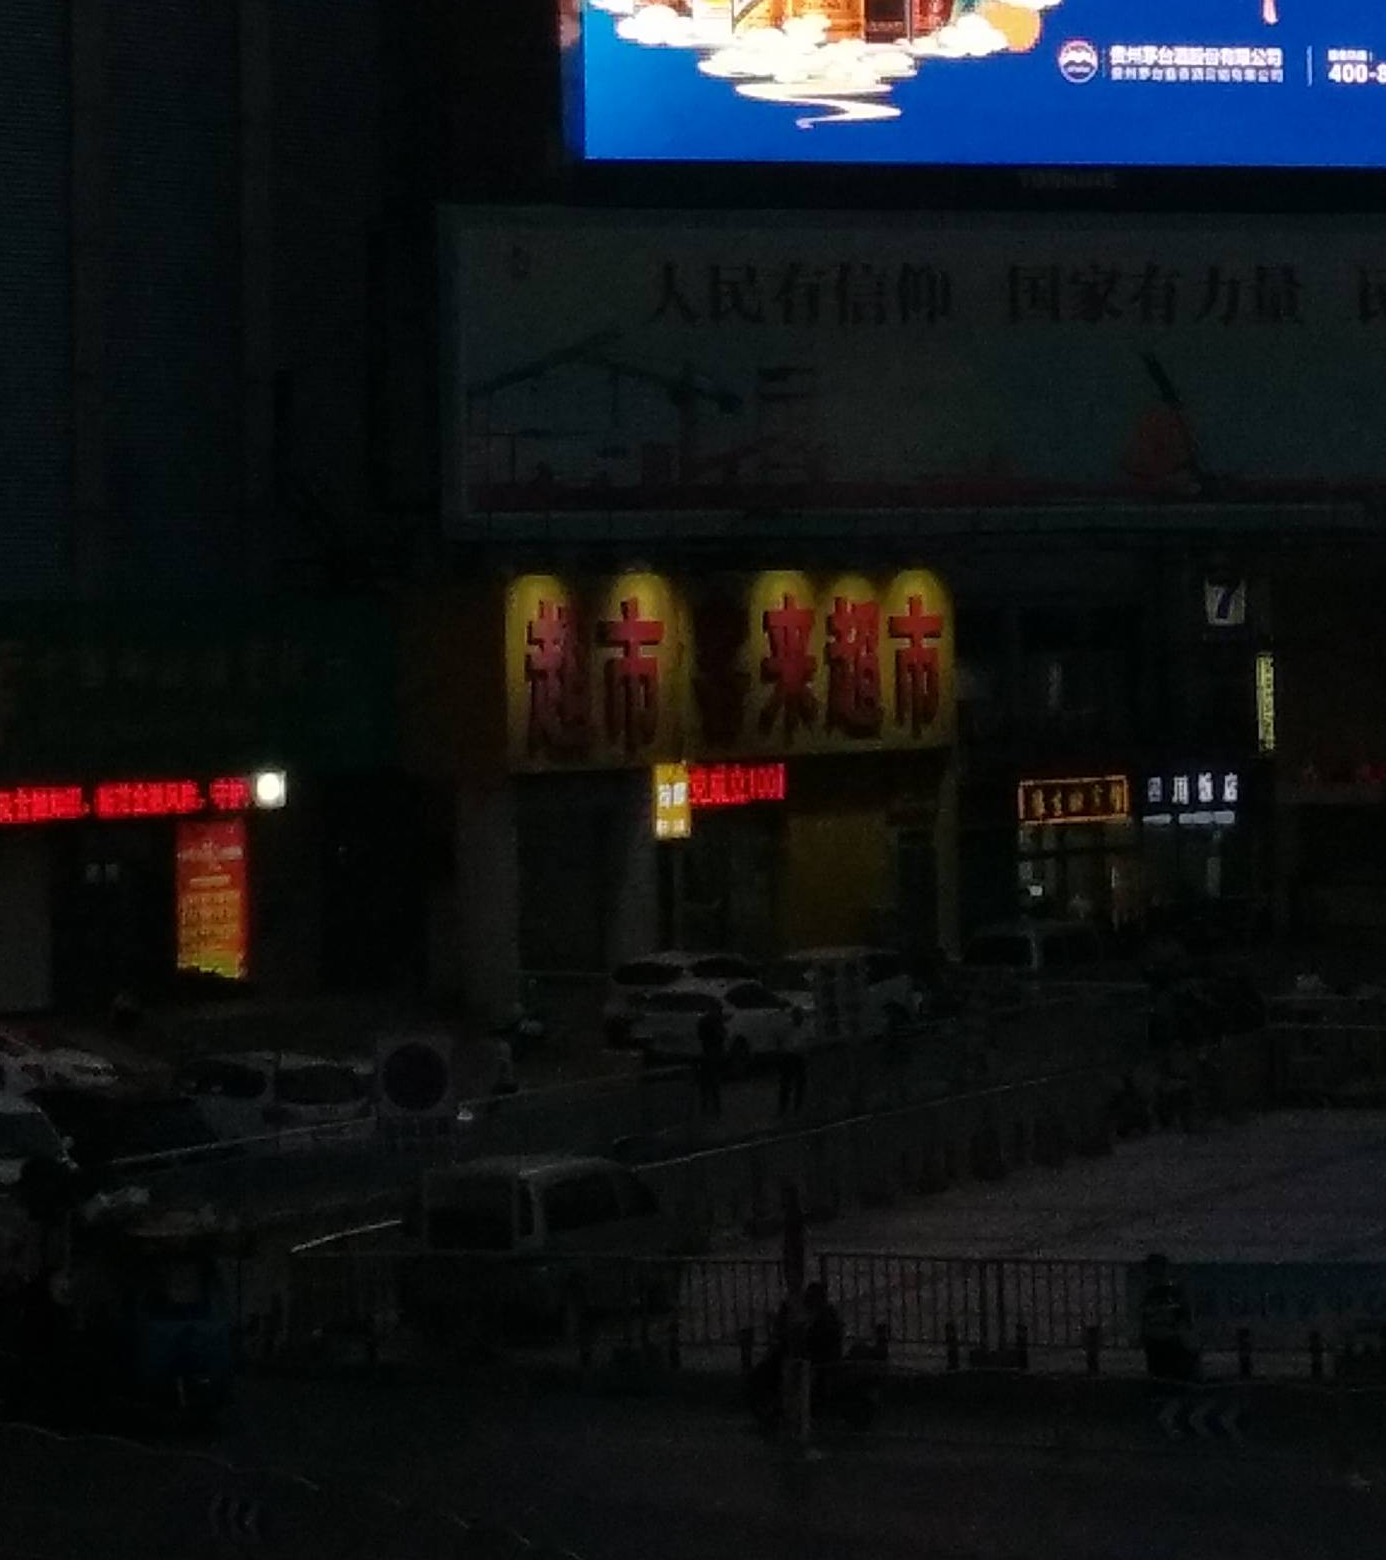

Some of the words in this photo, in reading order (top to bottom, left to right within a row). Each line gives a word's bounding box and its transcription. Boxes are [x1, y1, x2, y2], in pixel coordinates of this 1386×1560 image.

[649, 262, 951, 325] 人民有信仰
[1010, 262, 1303, 327] 国家有力量
[525, 596, 665, 760] 超市
